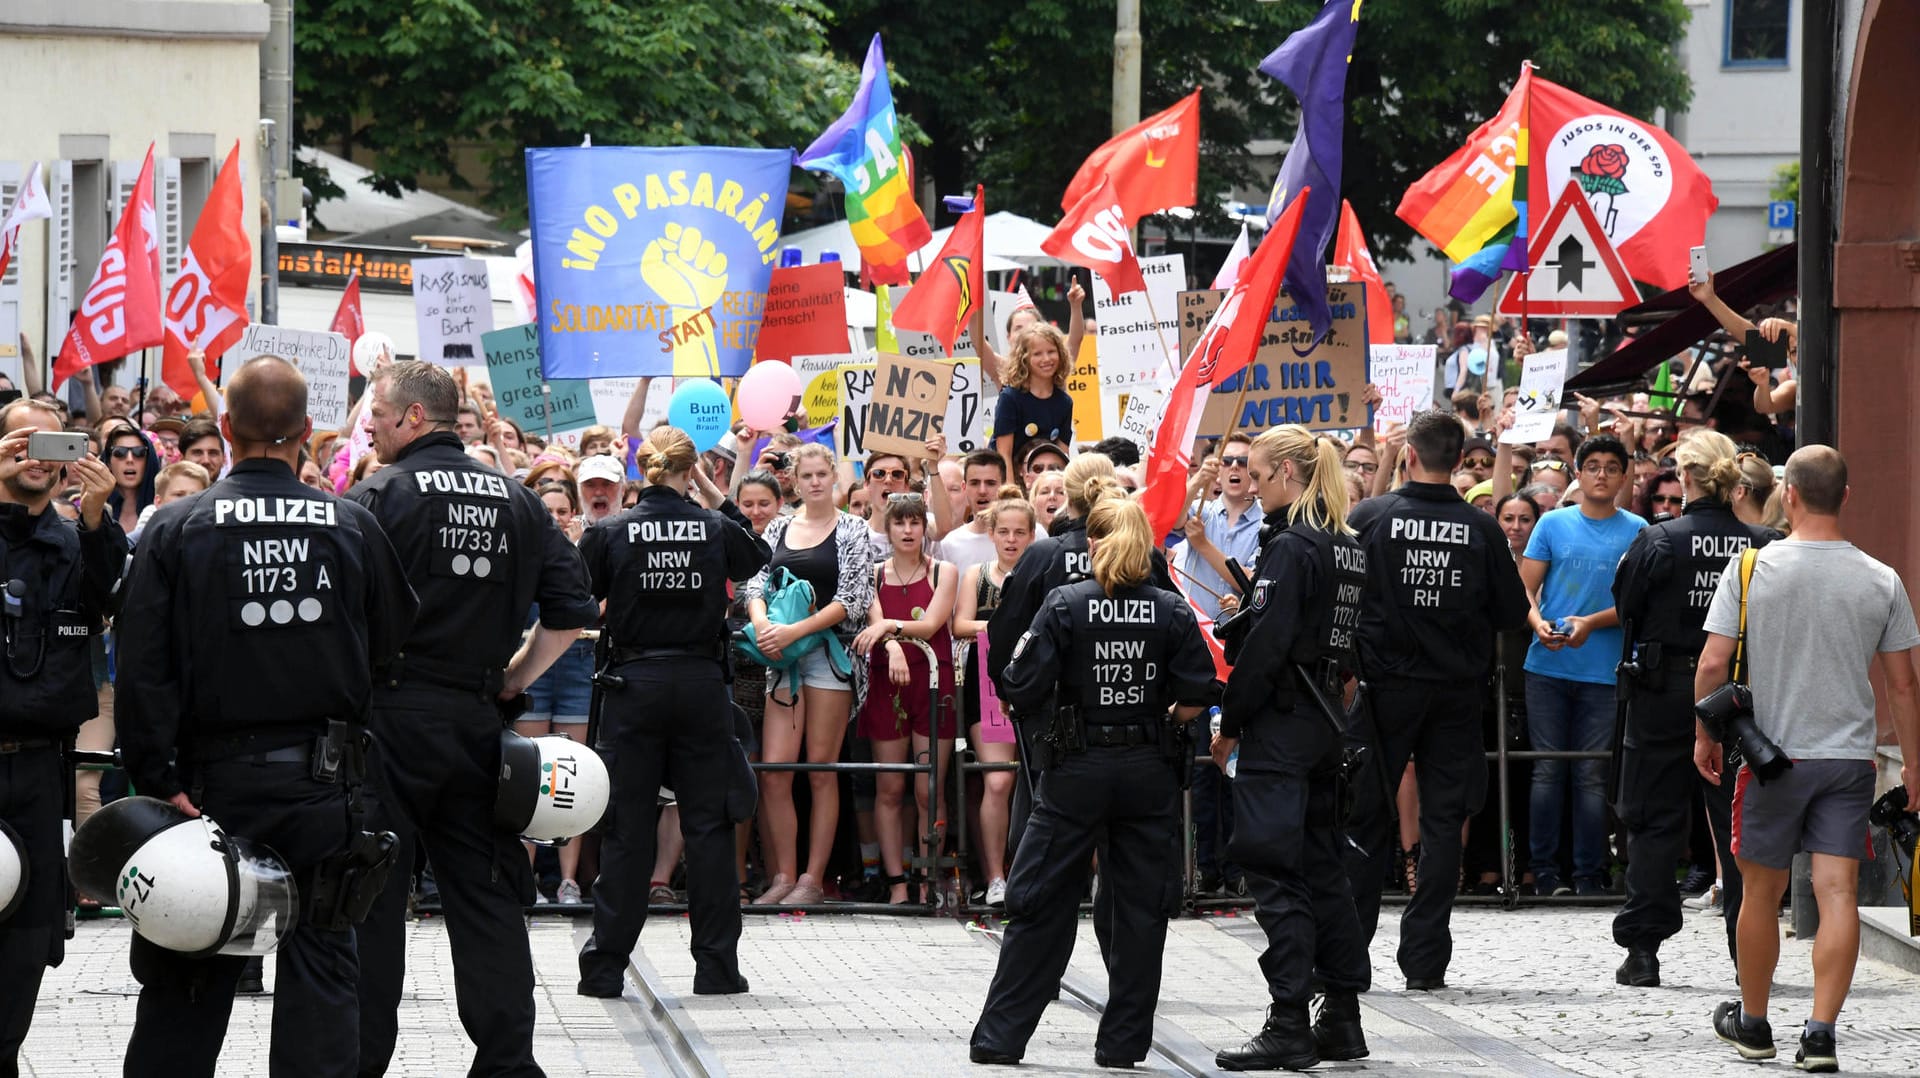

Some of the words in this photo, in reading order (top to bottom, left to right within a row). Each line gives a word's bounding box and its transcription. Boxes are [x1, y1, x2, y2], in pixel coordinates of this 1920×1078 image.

[1562, 123, 1602, 147] JUSOS
[1609, 125, 1624, 134] IN
[1629, 132, 1651, 152] DER
[1649, 155, 1662, 177] SPD
[1773, 205, 1789, 225] P
[767, 282, 800, 297] eine
[1185, 294, 1204, 307] Ich
[441, 317, 474, 336] Bart
[658, 306, 719, 353] STATT
[327, 337, 346, 360] Du
[1280, 360, 1336, 390] IHR
[1374, 361, 1418, 377] lernen!
[690, 403, 725, 414] Bunt
[1130, 396, 1150, 415] Der
[868, 402, 943, 442] NAZIS
[415, 471, 509, 499] POLIZEI
[215, 498, 335, 525] POLIZEI
[448, 503, 498, 528] NRW
[438, 526, 492, 551] 11733
[497, 533, 509, 554] A
[628, 520, 706, 543] POLIZEI
[1391, 518, 1470, 545] POLIZEI
[243, 538, 309, 565] NRW
[648, 551, 691, 569] NRW
[1333, 545, 1366, 574] POLIZEI
[1406, 549, 1450, 568] NRW
[243, 567, 297, 593] 1173
[317, 565, 331, 590] A
[640, 572, 686, 589] 11732
[691, 572, 702, 589] D
[1401, 567, 1444, 586] 11731
[1451, 570, 1462, 587] E
[1336, 583, 1362, 605] NRW
[1413, 589, 1440, 607] RH
[1088, 599, 1156, 624] POLIZEI
[1333, 605, 1354, 626] 1172
[58, 625, 88, 636] POLIZEI
[1095, 641, 1145, 660] NRW
[1092, 664, 1133, 683] 1173
[1145, 664, 1157, 681] D
[1100, 686, 1144, 706] BeSi
